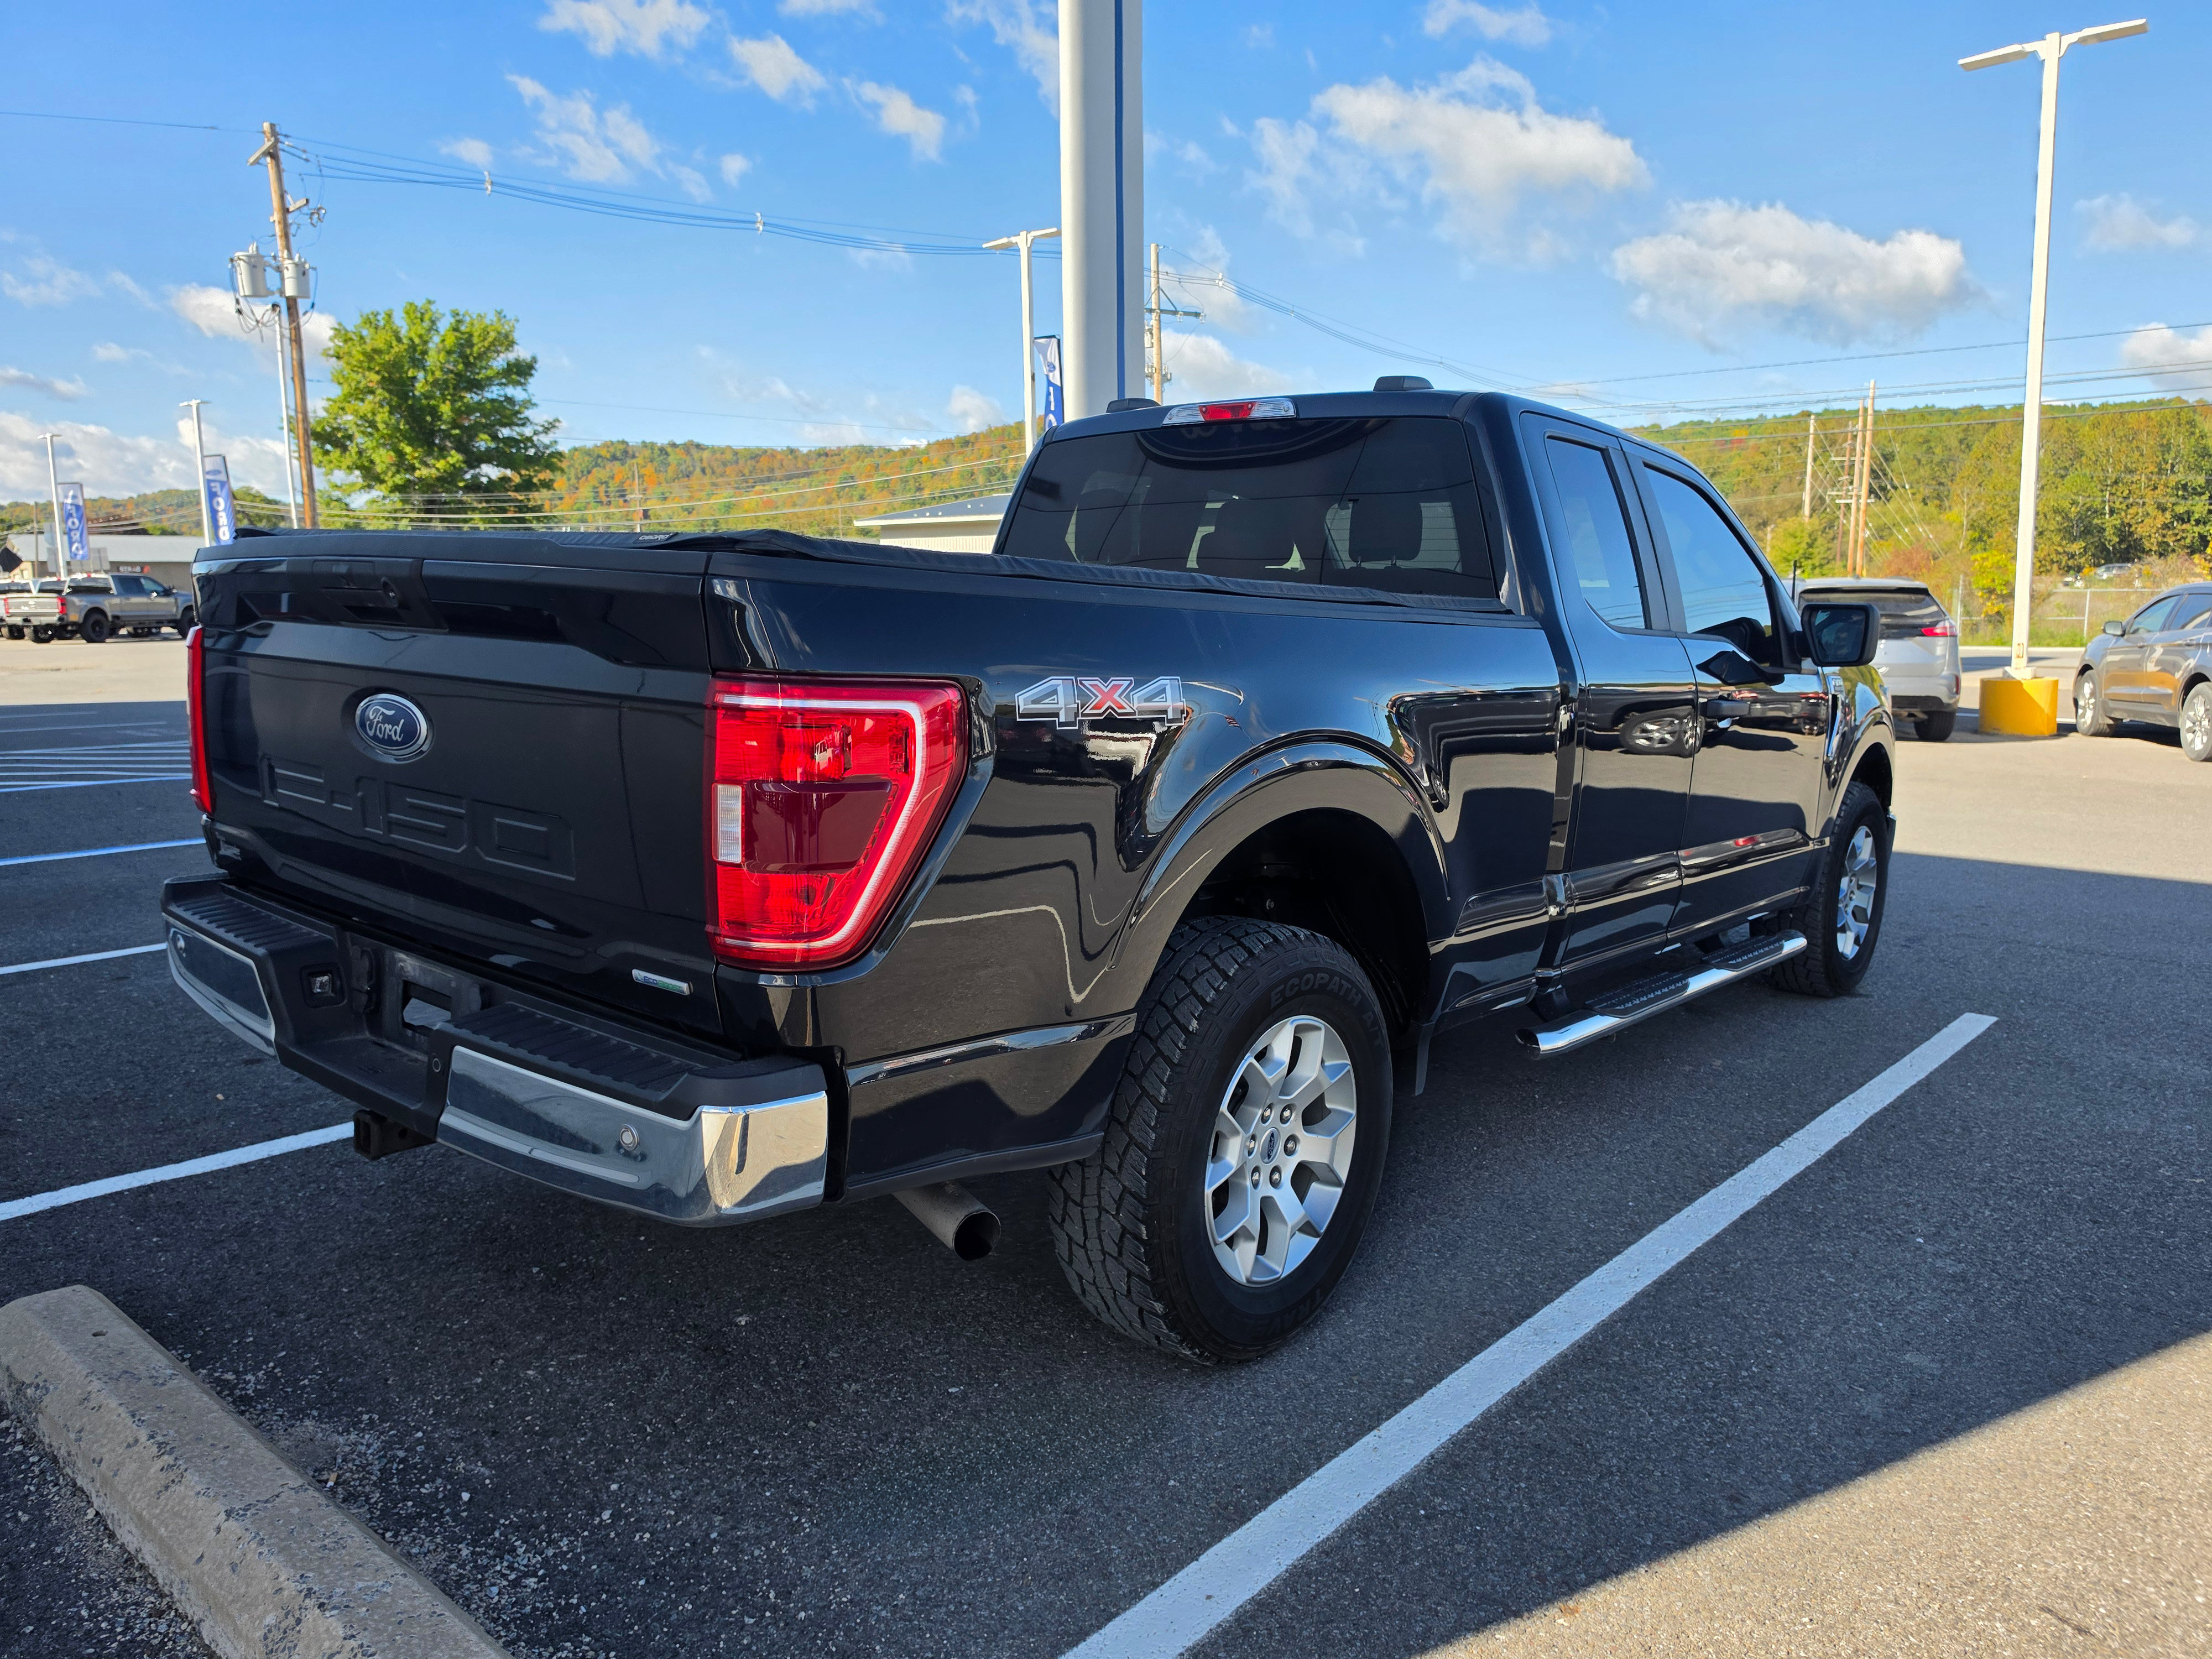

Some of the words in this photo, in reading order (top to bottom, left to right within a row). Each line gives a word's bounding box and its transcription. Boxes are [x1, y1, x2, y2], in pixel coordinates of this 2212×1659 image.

[366, 706, 405, 742] Ford
[1015, 676, 1186, 730] 4X4
[258, 753, 576, 881] F-150
[1271, 973, 1363, 1009] ECOPATH
